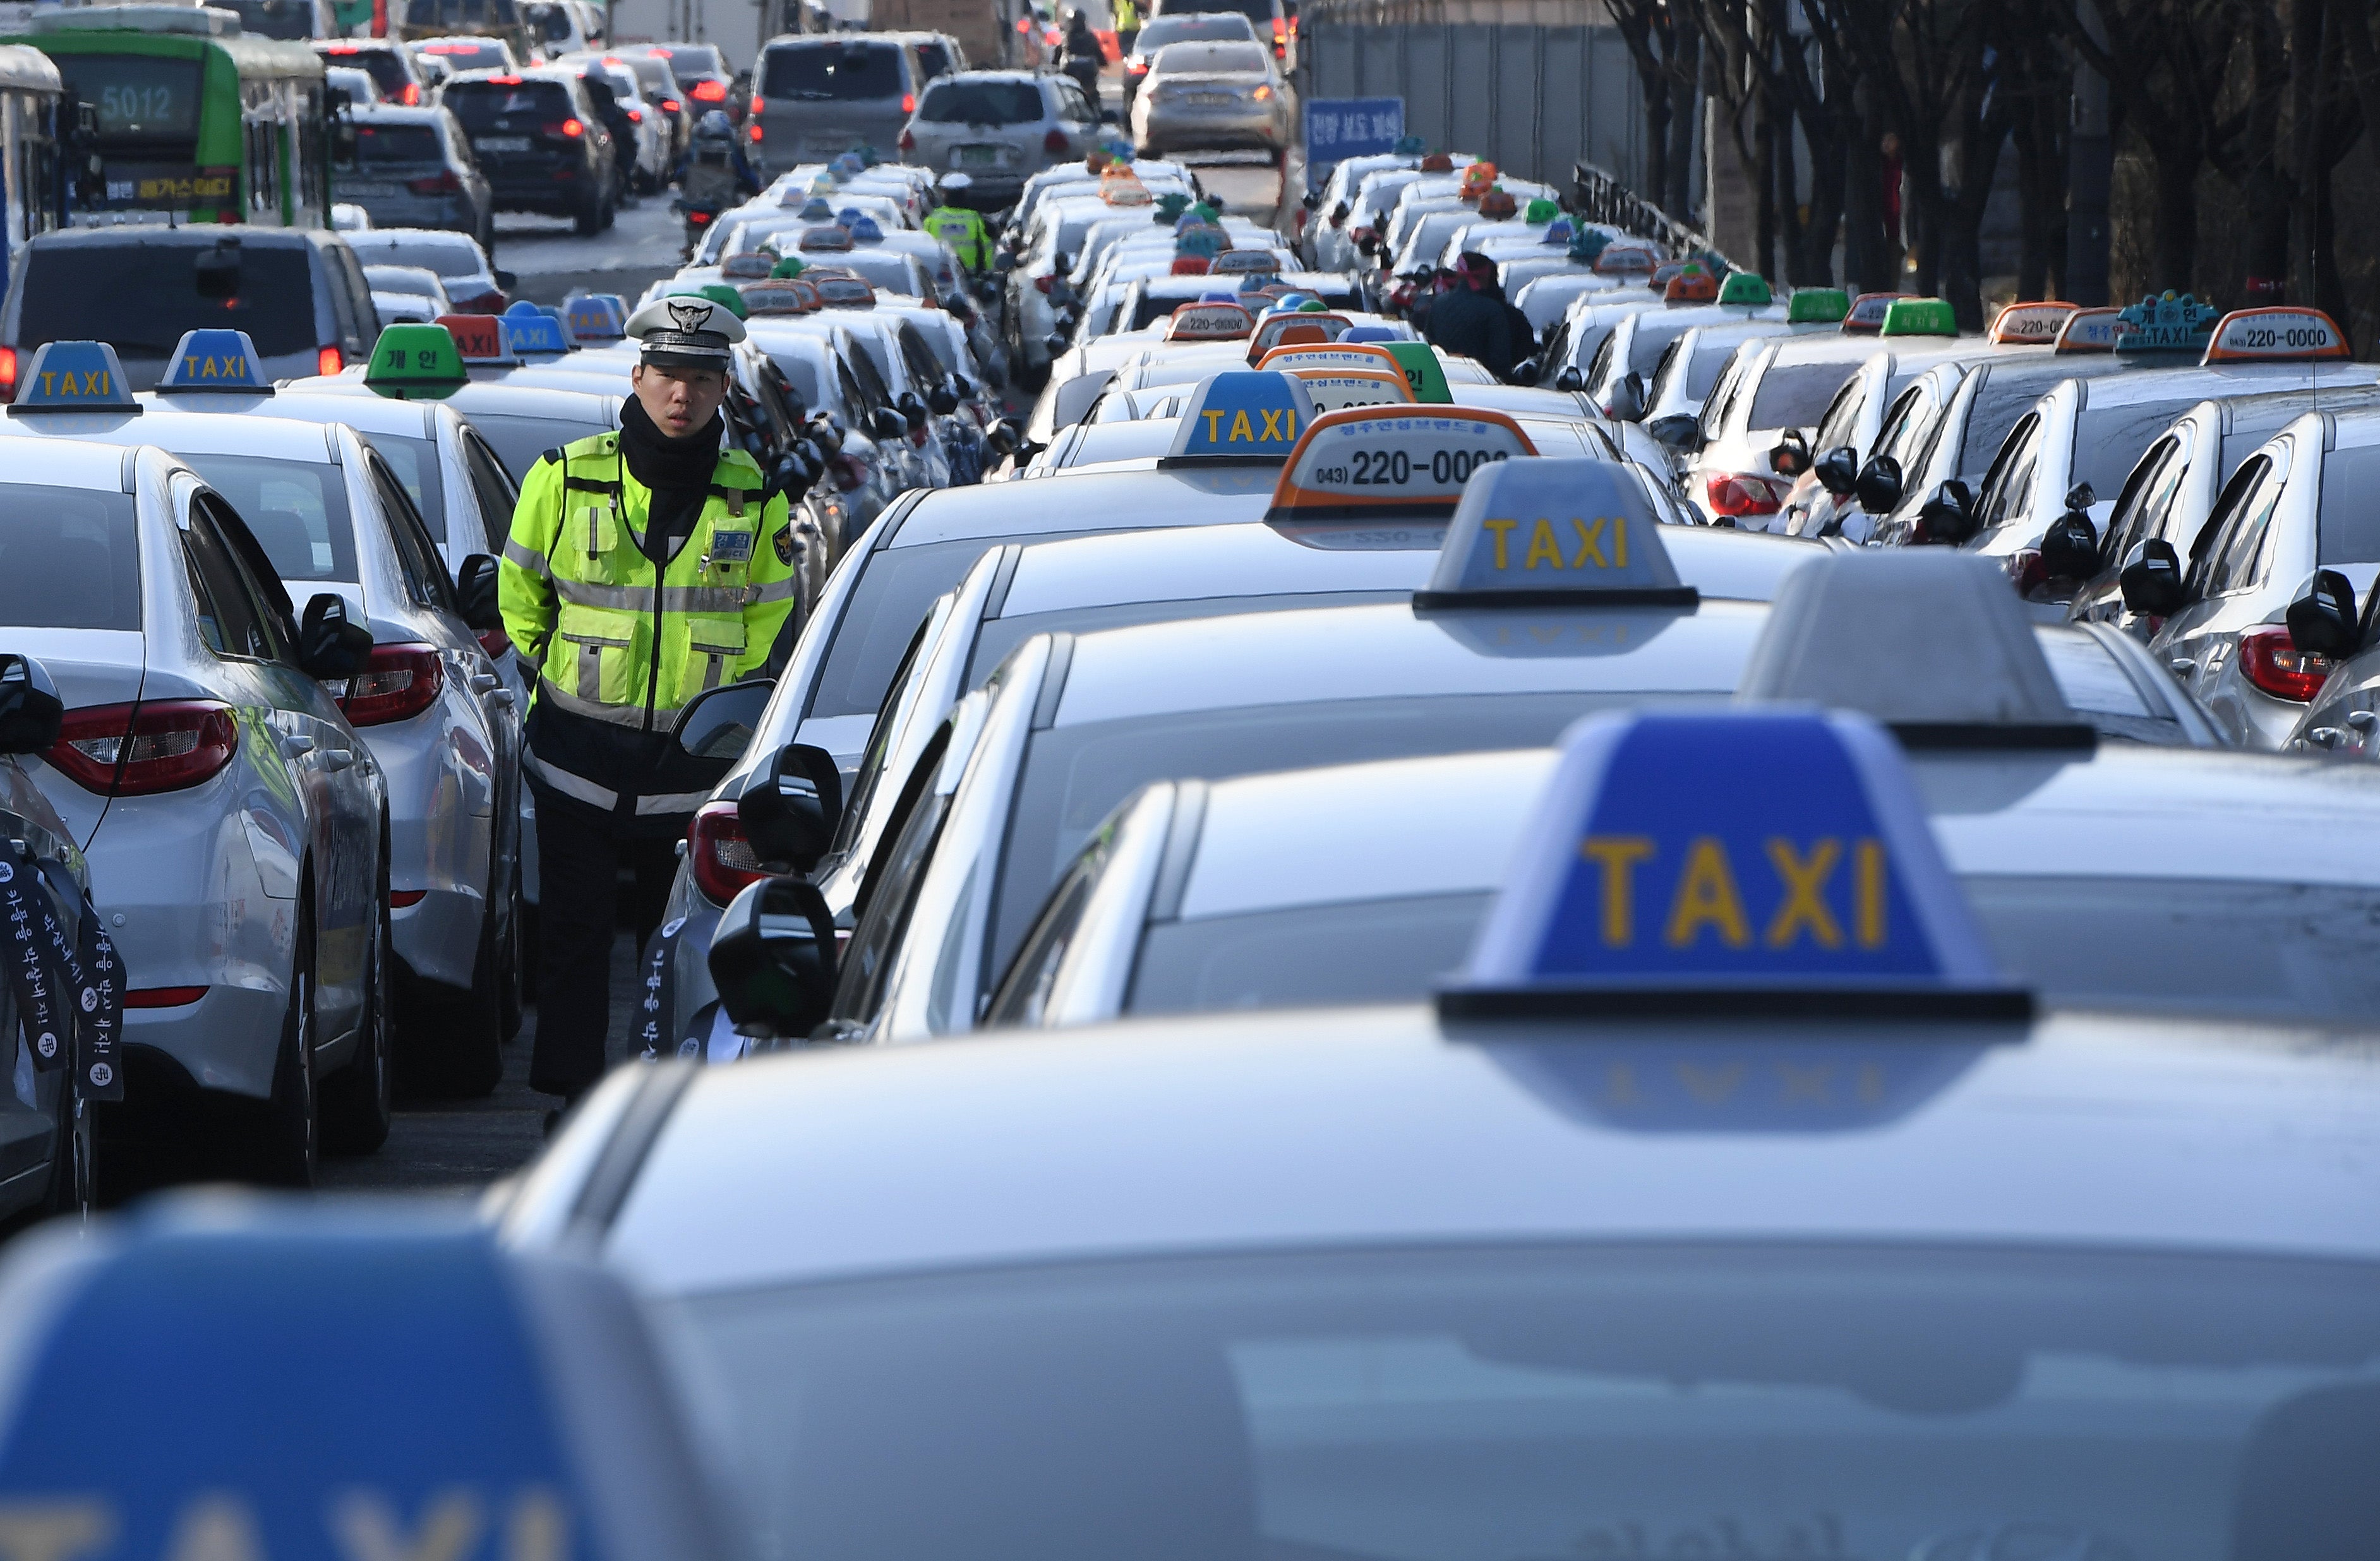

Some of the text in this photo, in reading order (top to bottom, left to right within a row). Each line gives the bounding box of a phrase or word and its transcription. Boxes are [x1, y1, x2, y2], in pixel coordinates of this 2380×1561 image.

[102, 86, 171, 120] 5012
[455, 332, 493, 354] AXI
[507, 326, 549, 345] AXI
[2151, 326, 2189, 344] TAXI
[2247, 328, 2327, 347] 220-0000
[184, 356, 246, 378] TAXI
[40, 371, 110, 397] TAXI
[1303, 379, 1381, 390] 안심브랜드콜
[1404, 369, 1423, 392] 인
[1201, 409, 1296, 442] TAXI
[1483, 518, 1629, 570] TAXI
[1580, 836, 1885, 949] TAXI
[6, 889, 33, 942] 카풀을
